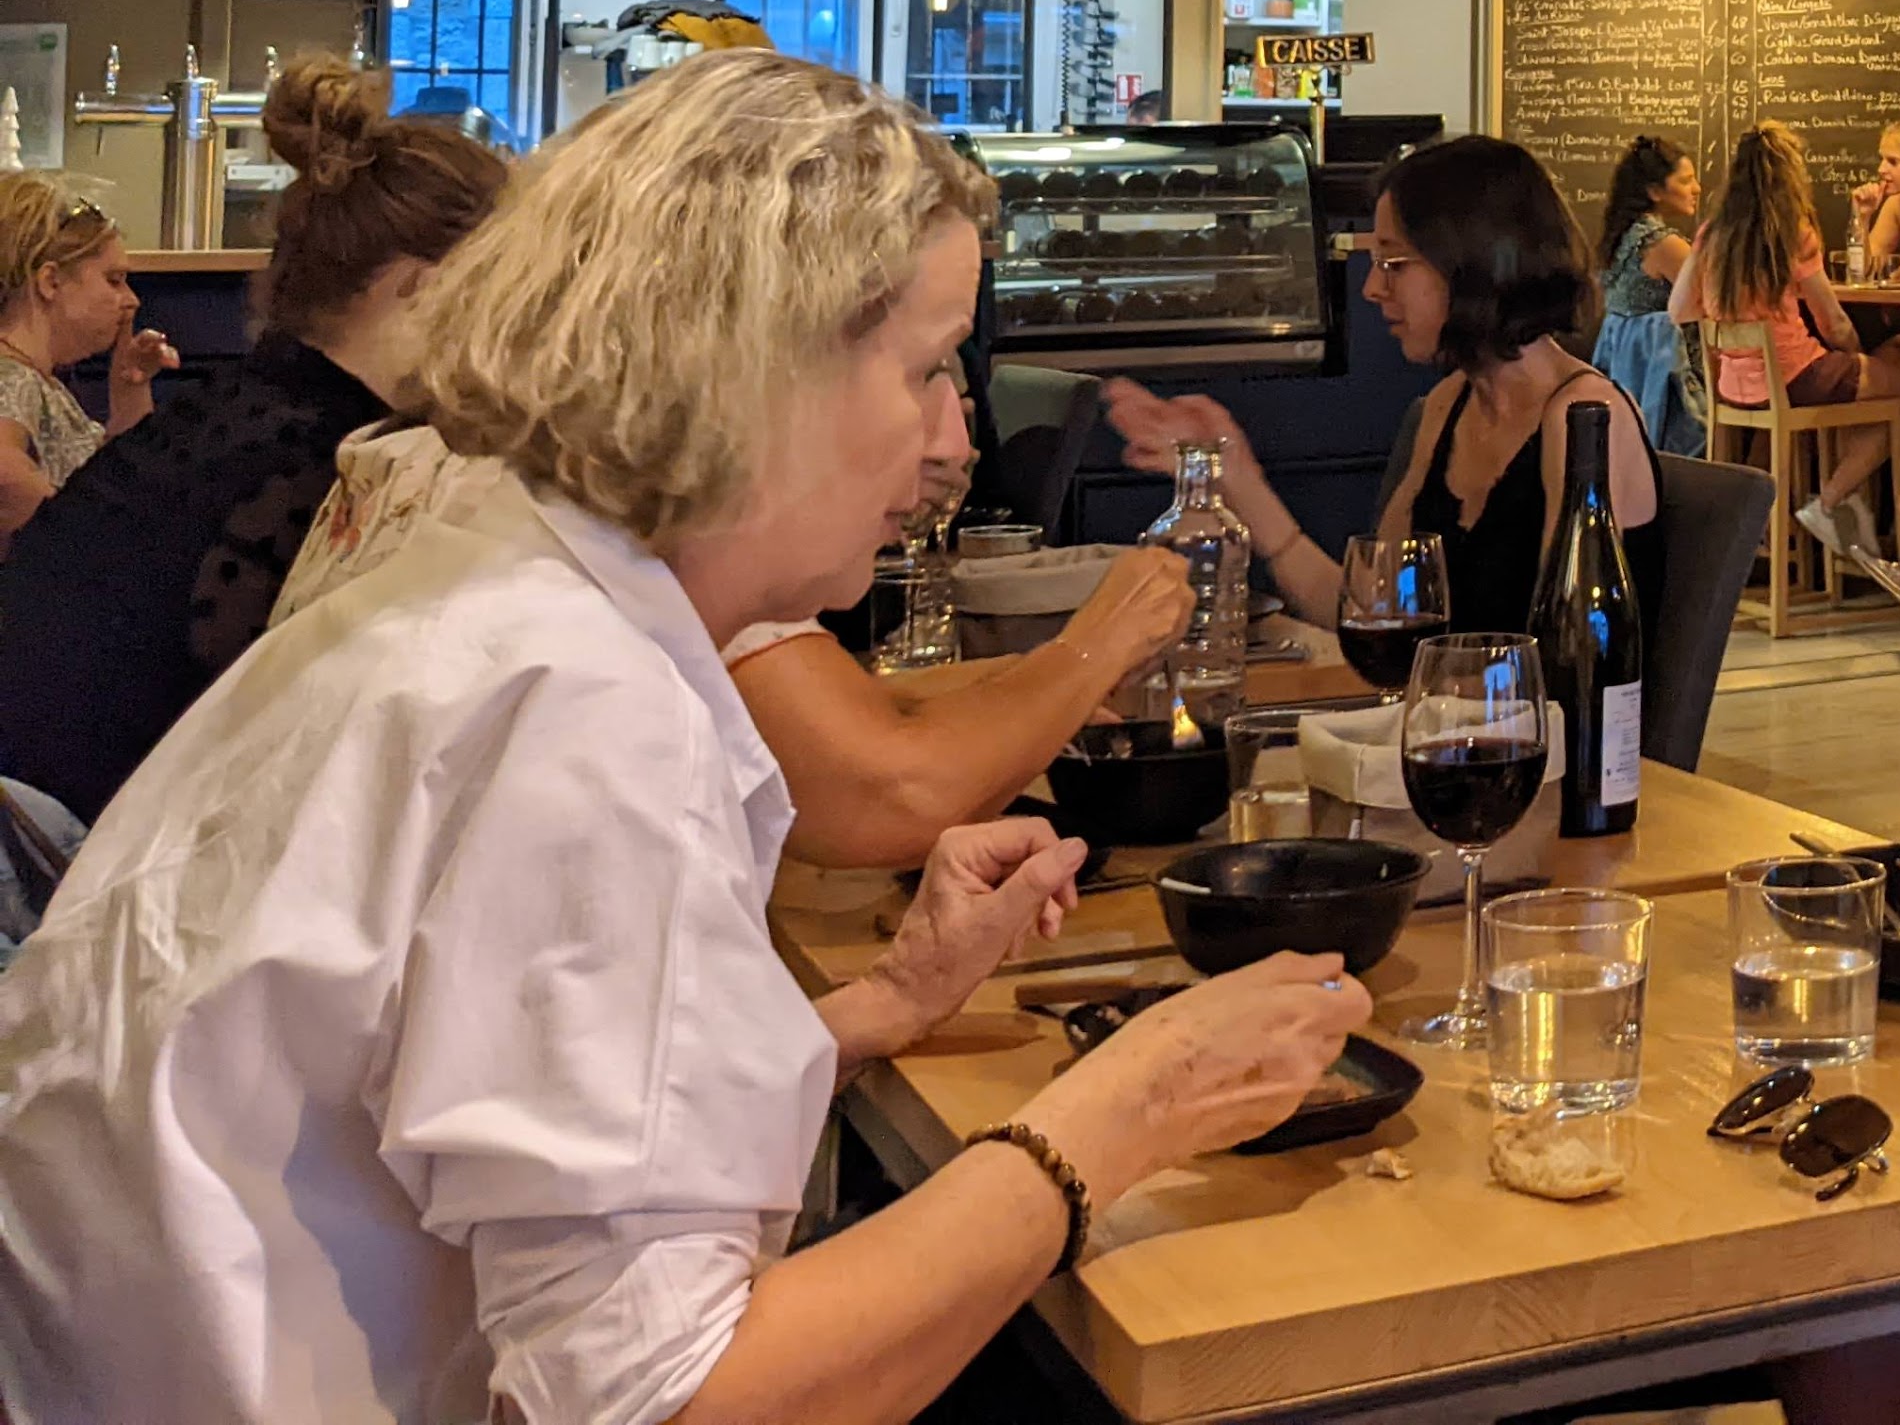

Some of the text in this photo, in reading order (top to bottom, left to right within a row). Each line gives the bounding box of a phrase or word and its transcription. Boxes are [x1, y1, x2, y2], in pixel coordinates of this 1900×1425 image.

[1731, 15, 1749, 29] 48
[1272, 36, 1362, 64] CAISSE
[1731, 78, 1749, 94] 65
